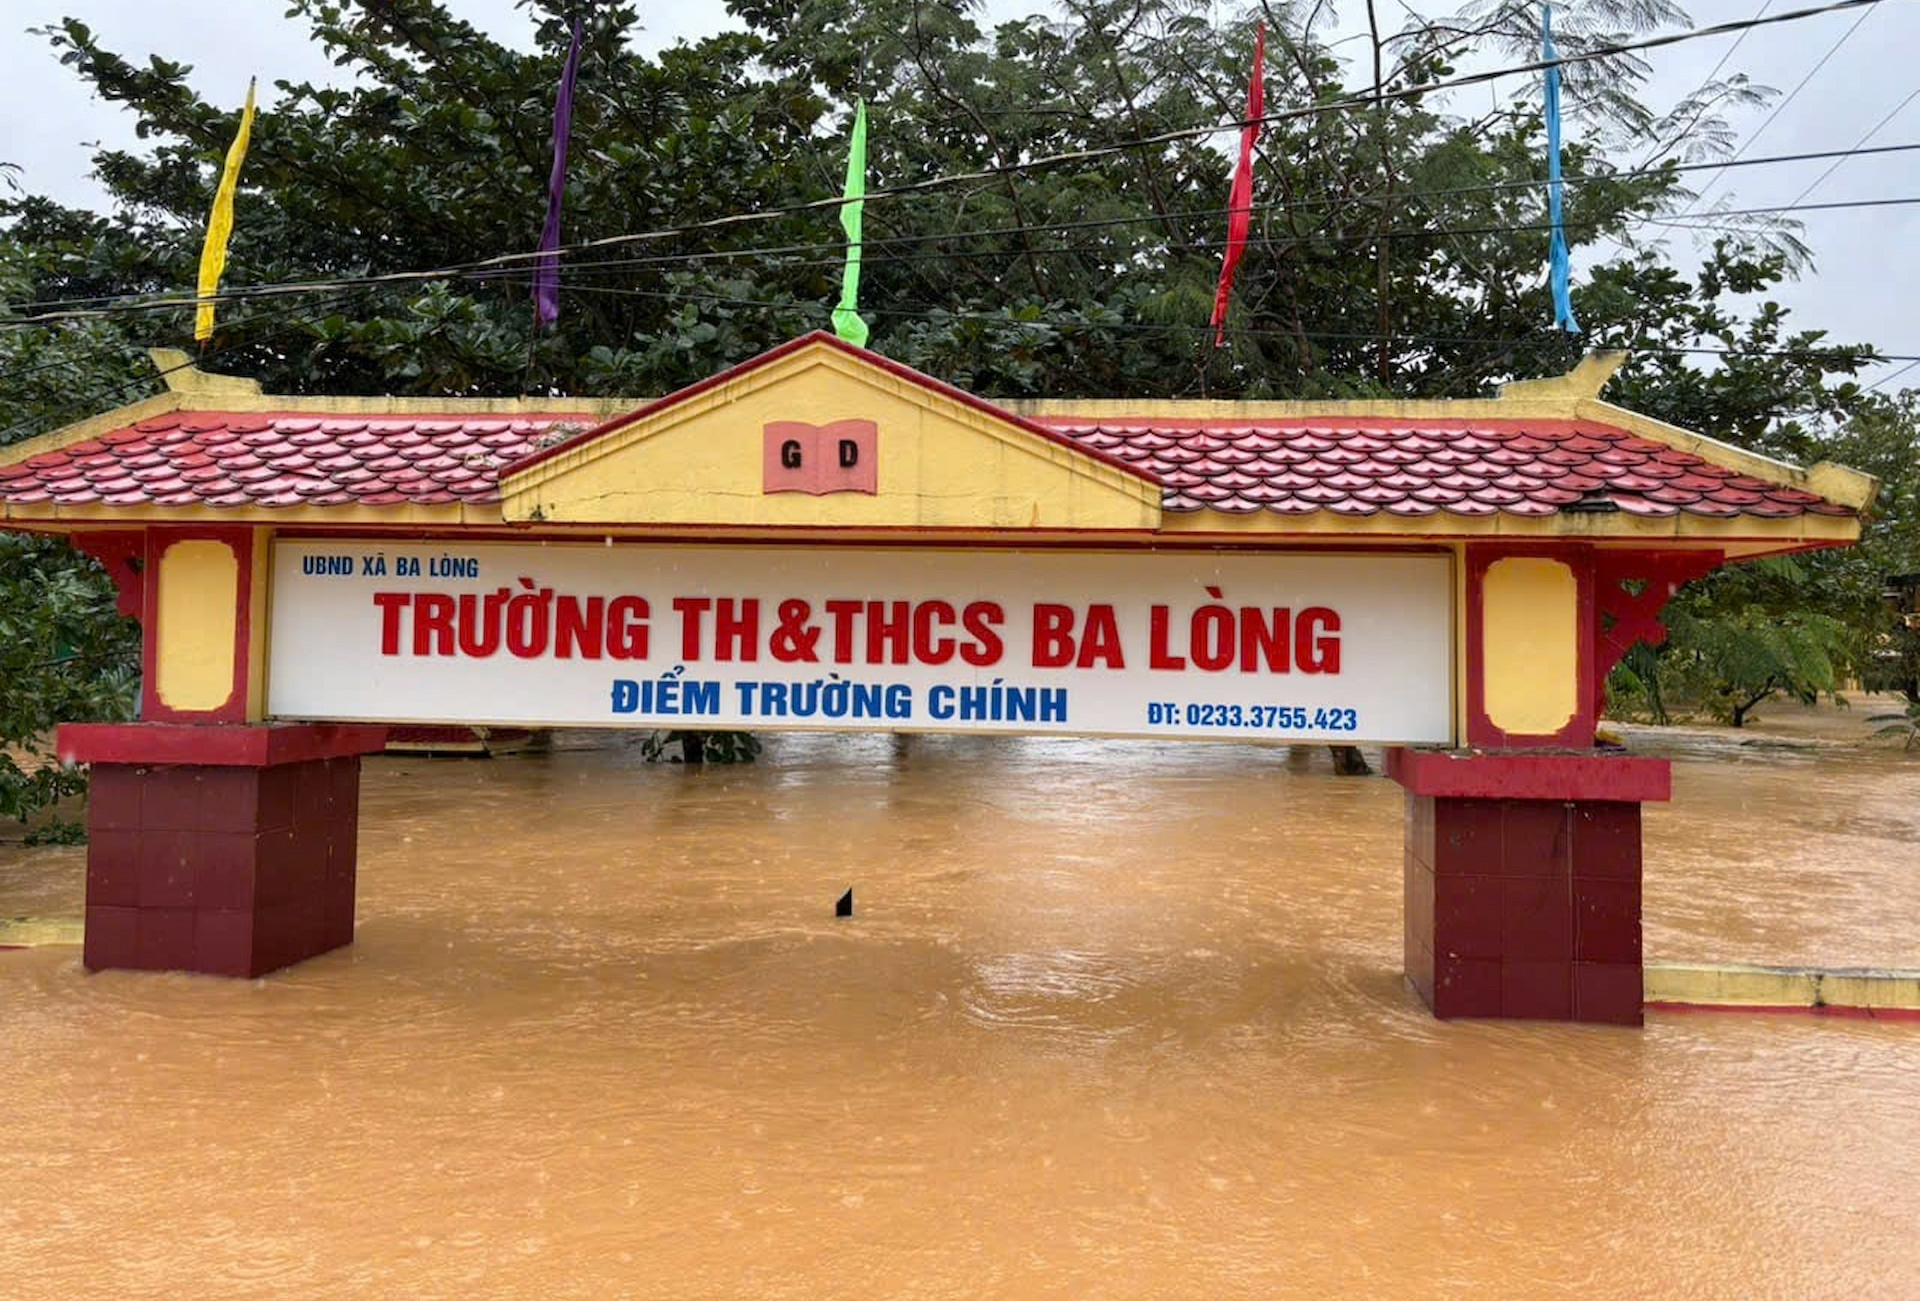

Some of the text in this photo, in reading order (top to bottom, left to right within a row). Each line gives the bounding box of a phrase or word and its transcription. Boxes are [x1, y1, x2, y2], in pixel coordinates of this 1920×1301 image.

[781, 439, 858, 469] G D
[303, 555, 353, 575] UBND
[362, 552, 386, 576] XÃ
[396, 556, 420, 577] BA
[373, 577, 651, 662] TRƯỜNG
[1031, 603, 1127, 671] BA
[1149, 586, 1342, 676] LÒNG
[610, 665, 1068, 723] ĐIỂM TRƯỜNG CHÍNH
[1147, 702, 1358, 732] ĐT: 0233.3755.423
